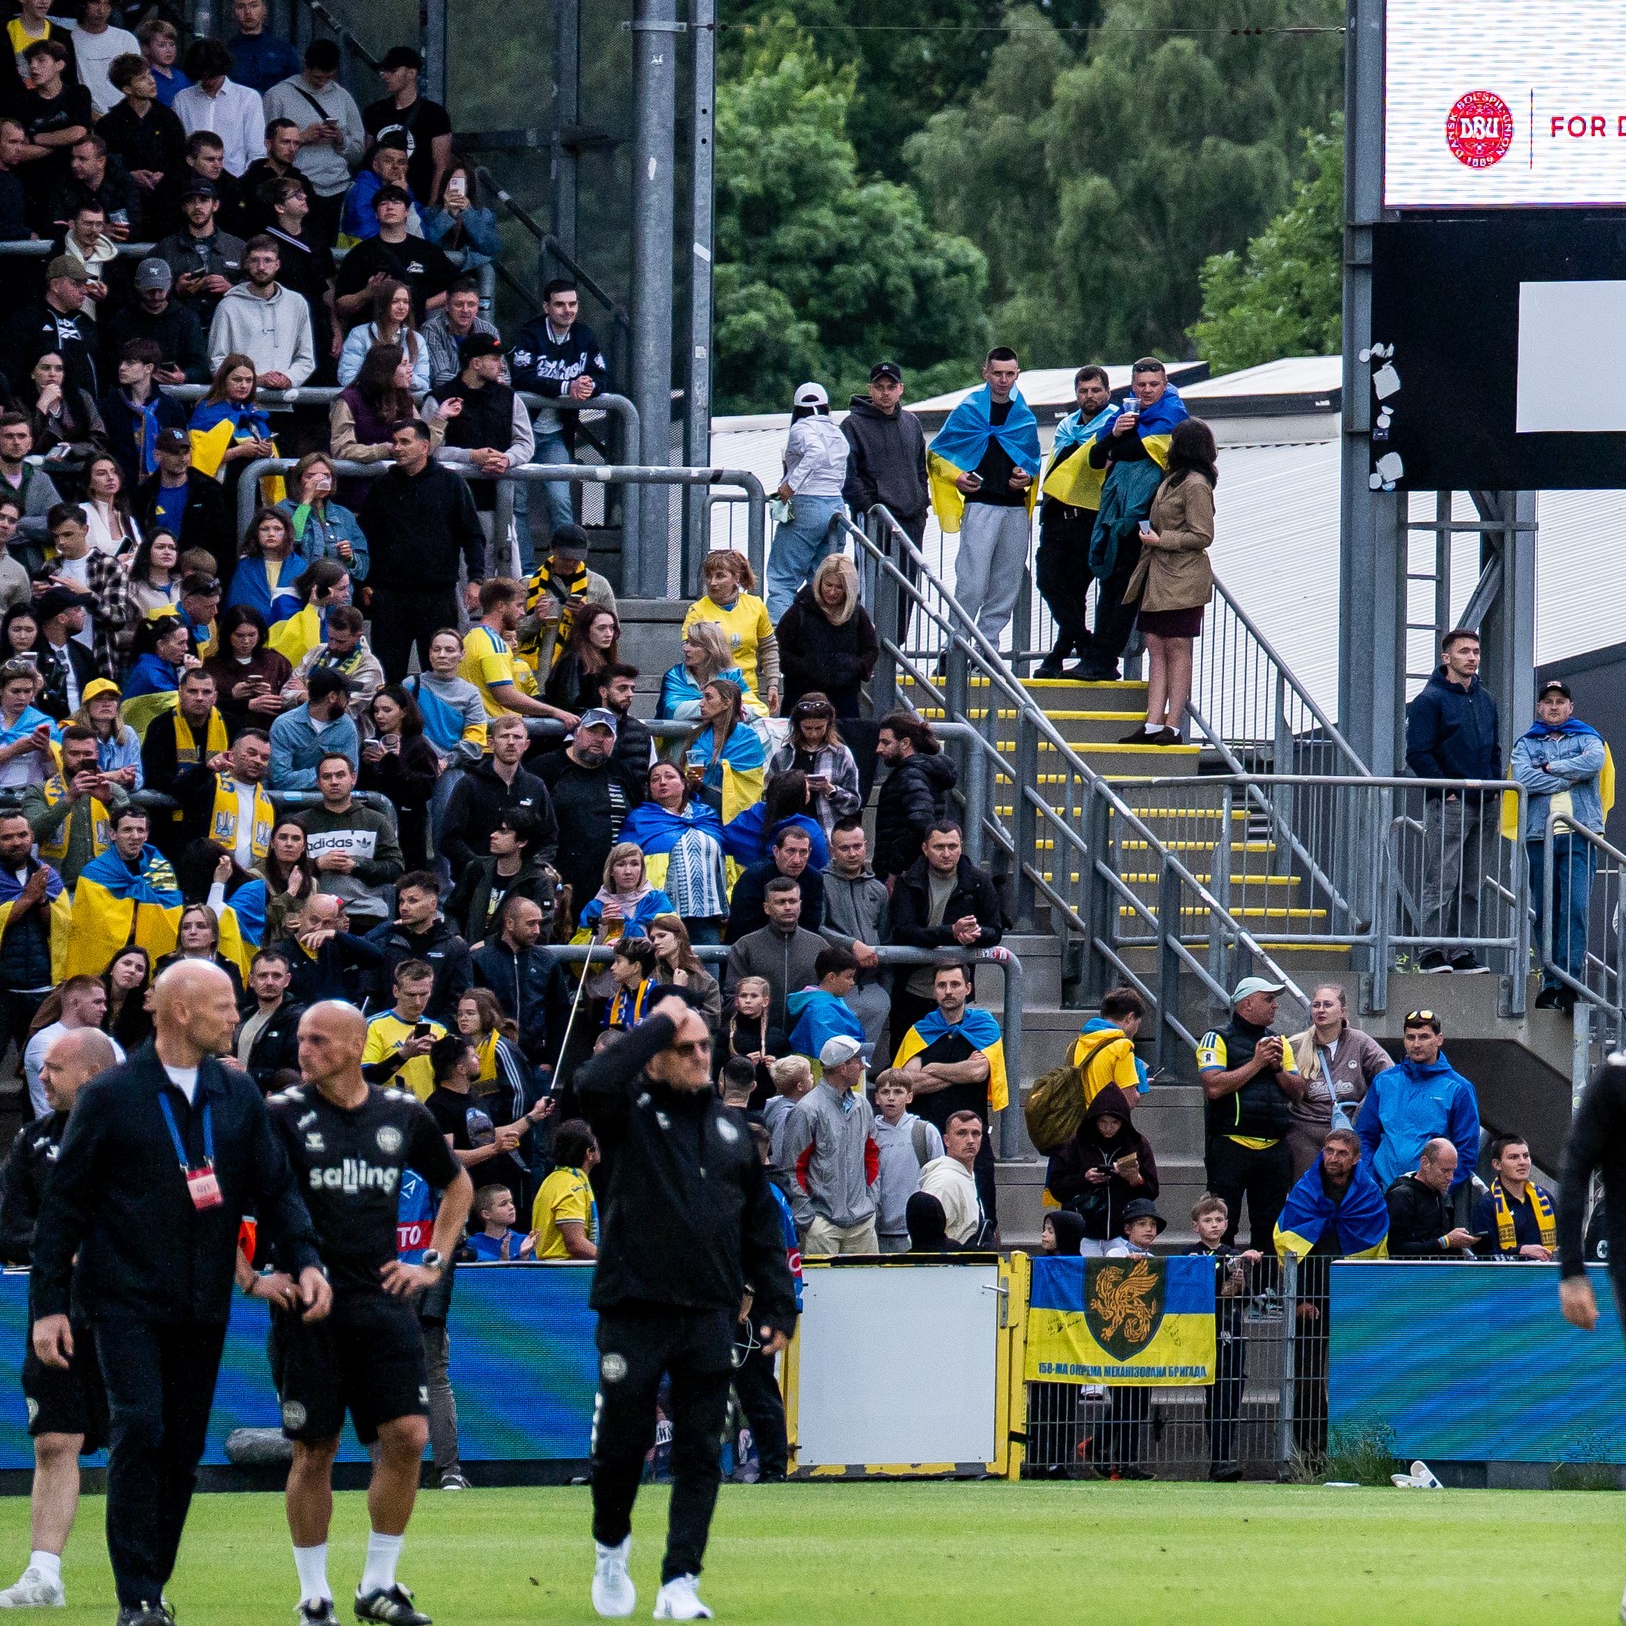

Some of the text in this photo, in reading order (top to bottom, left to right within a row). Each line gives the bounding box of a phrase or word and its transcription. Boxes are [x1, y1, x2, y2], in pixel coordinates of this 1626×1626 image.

[1460, 117, 1500, 142] DBU
[1551, 116, 1608, 138] FOR
[309, 836, 354, 851] adidas
[309, 1158, 400, 1195] salling
